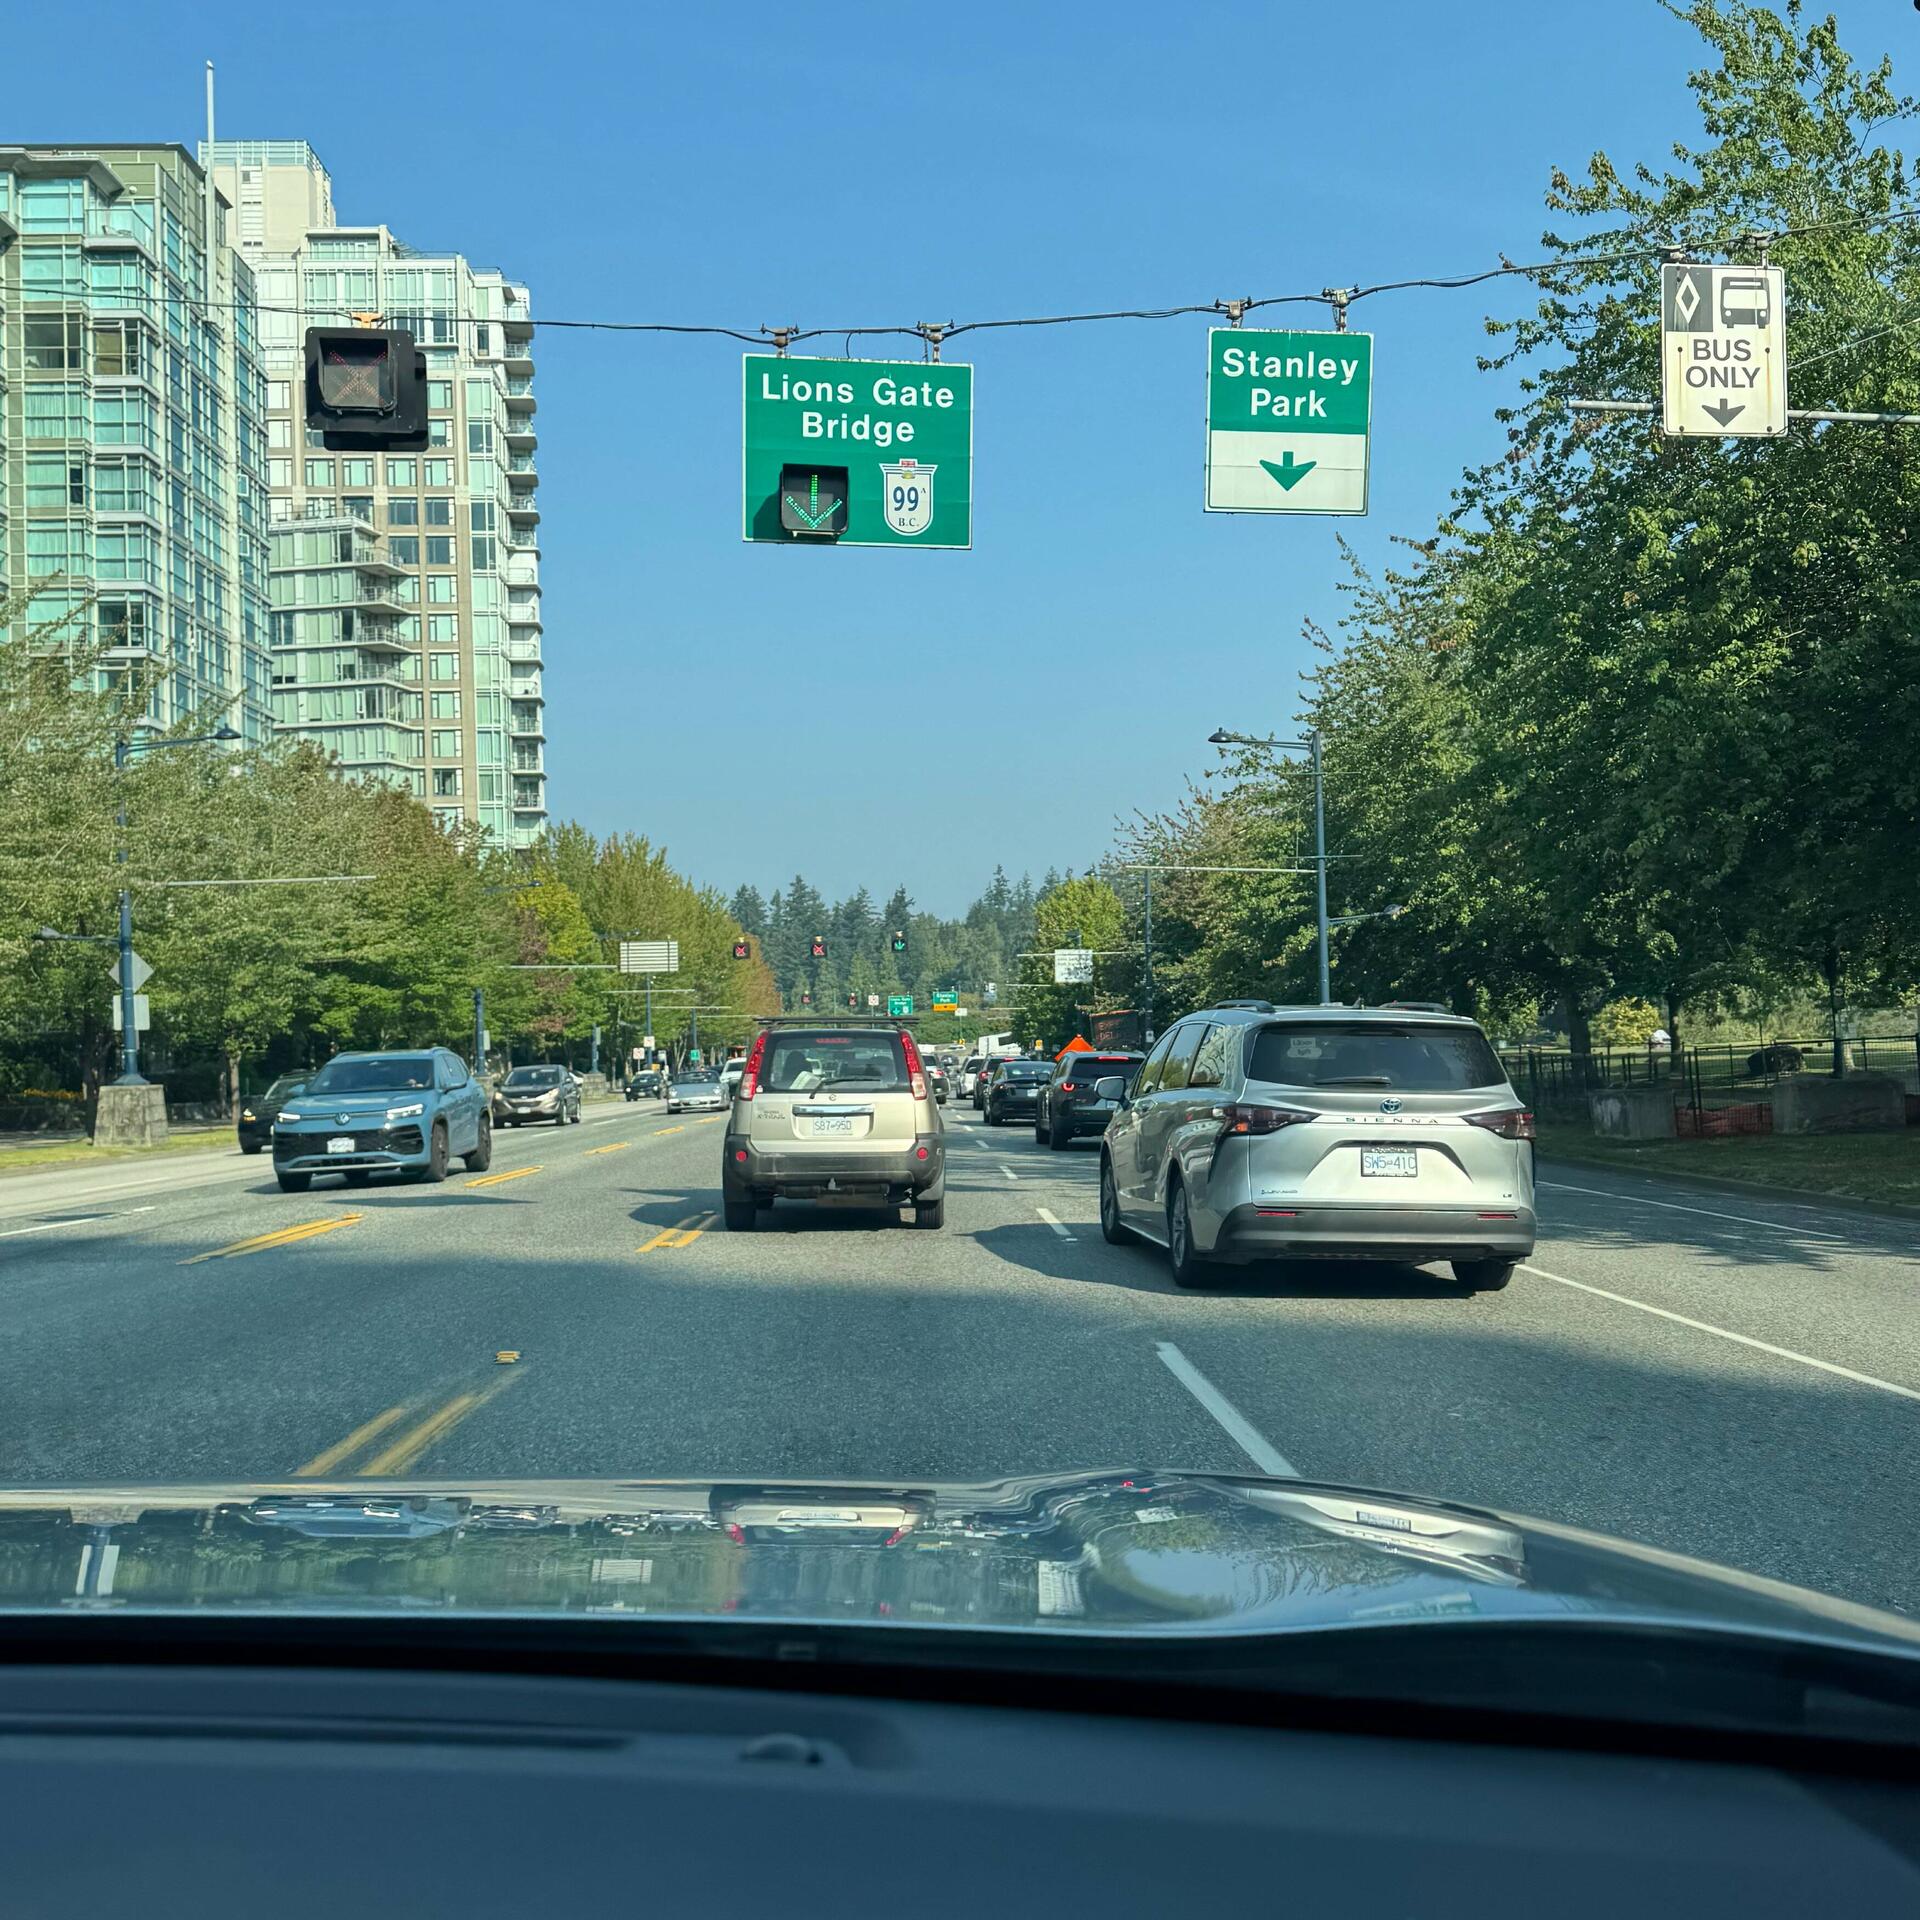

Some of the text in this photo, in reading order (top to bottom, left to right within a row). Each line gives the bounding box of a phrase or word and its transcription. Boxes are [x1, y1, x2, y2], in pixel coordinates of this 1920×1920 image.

[1693, 339, 1752, 362] BUS
[1222, 347, 1359, 386] Stanley
[1685, 365, 1761, 389] ONLY
[762, 373, 954, 408] Lions Gate
[1250, 387, 1327, 418] Park
[802, 411, 915, 447] Bridge
[893, 486, 919, 512] 99
